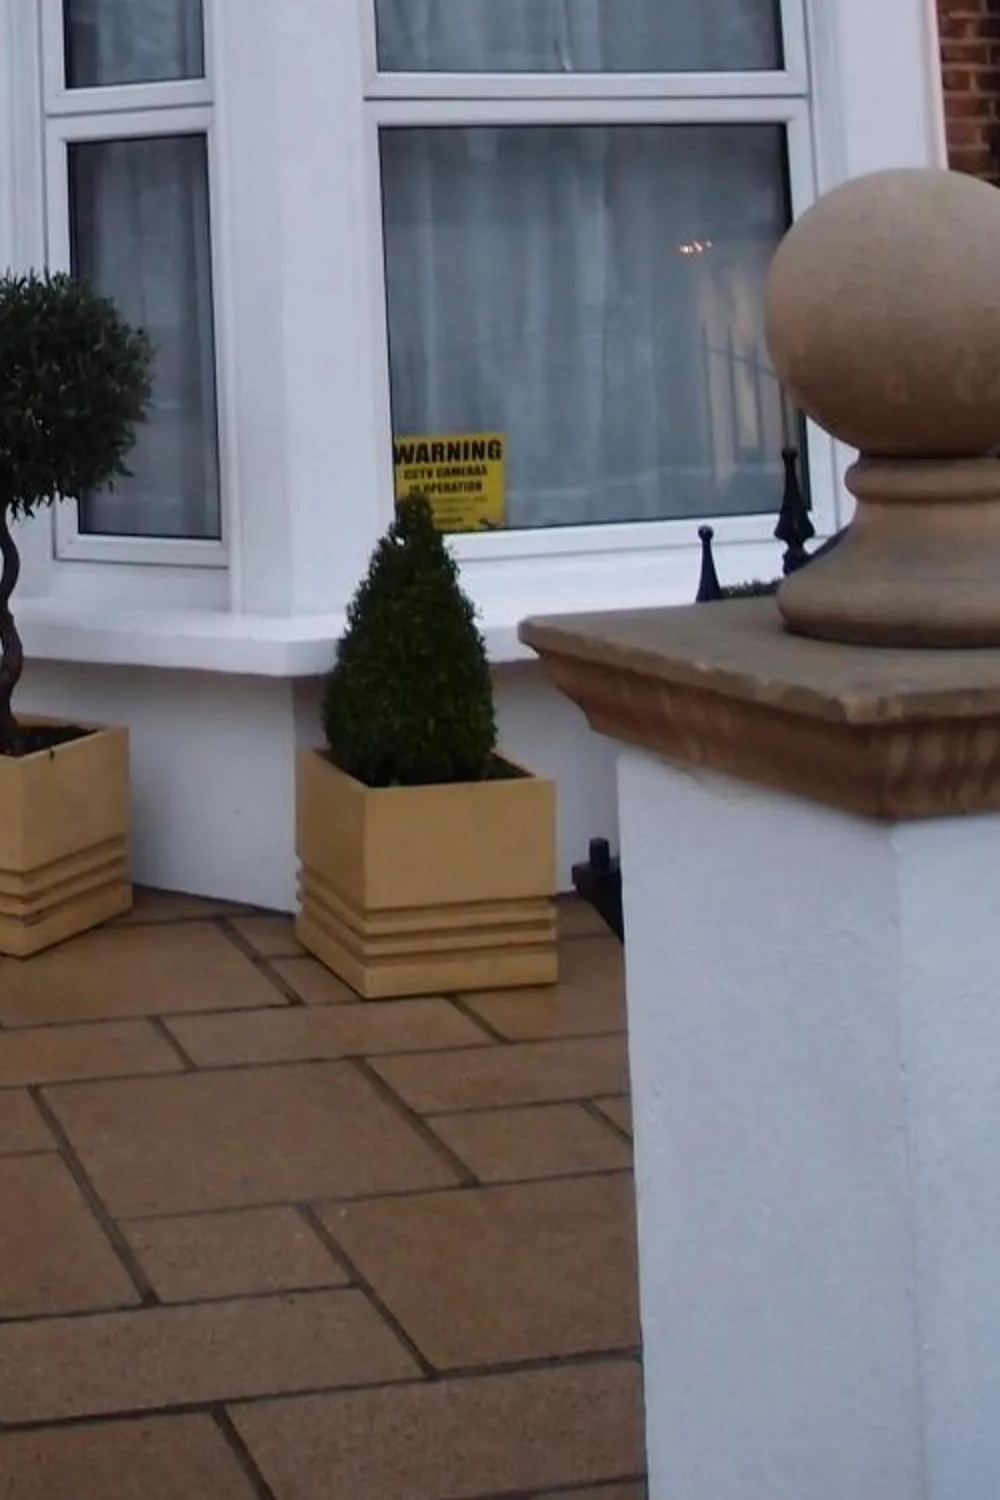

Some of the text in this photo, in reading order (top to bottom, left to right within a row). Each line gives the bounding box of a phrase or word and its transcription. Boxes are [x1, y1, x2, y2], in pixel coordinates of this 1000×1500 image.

[395, 439, 502, 464] WARNING
[403, 467, 433, 479] CCTV
[423, 480, 483, 493] OPERATION
